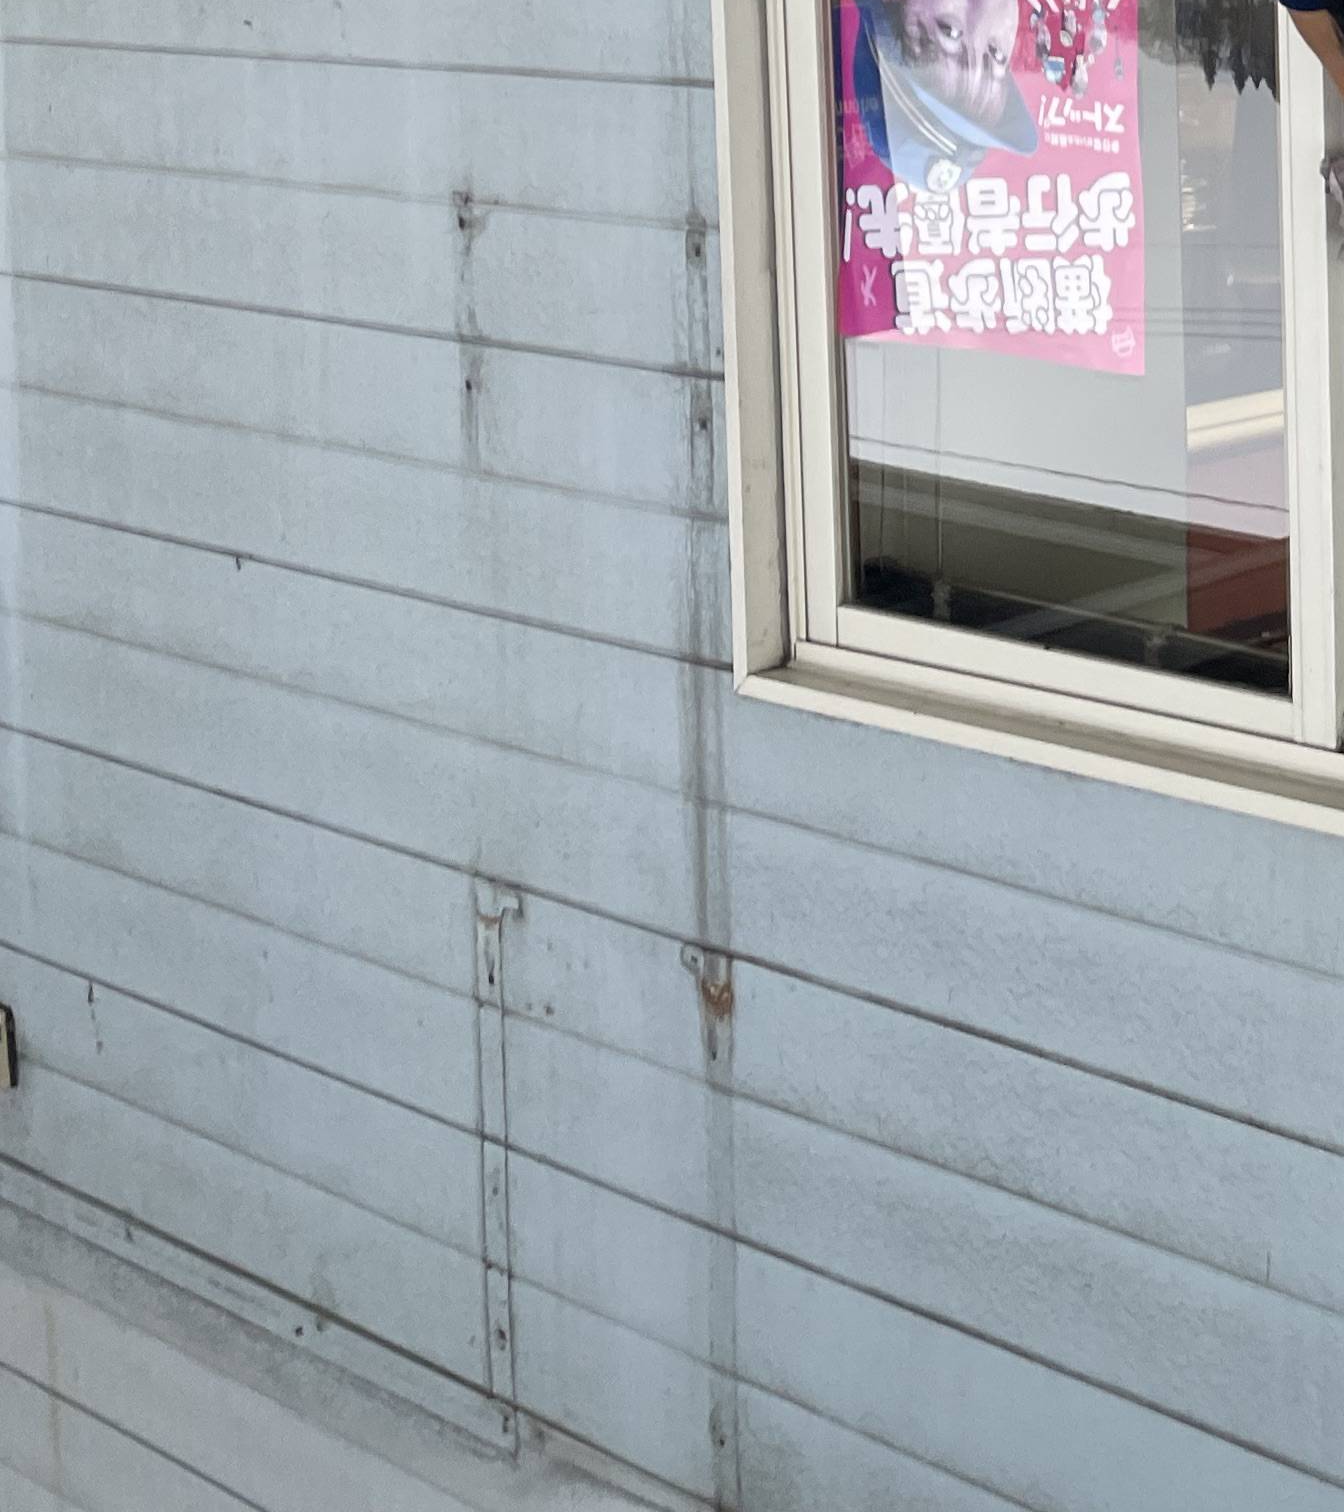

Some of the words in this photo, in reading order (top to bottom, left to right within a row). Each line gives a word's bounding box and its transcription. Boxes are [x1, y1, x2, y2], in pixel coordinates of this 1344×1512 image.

[1038, 94, 1126, 134] ストップ!
[842, 171, 1136, 262] 歩行者優先!
[890, 254, 1113, 336] 横断歩道
